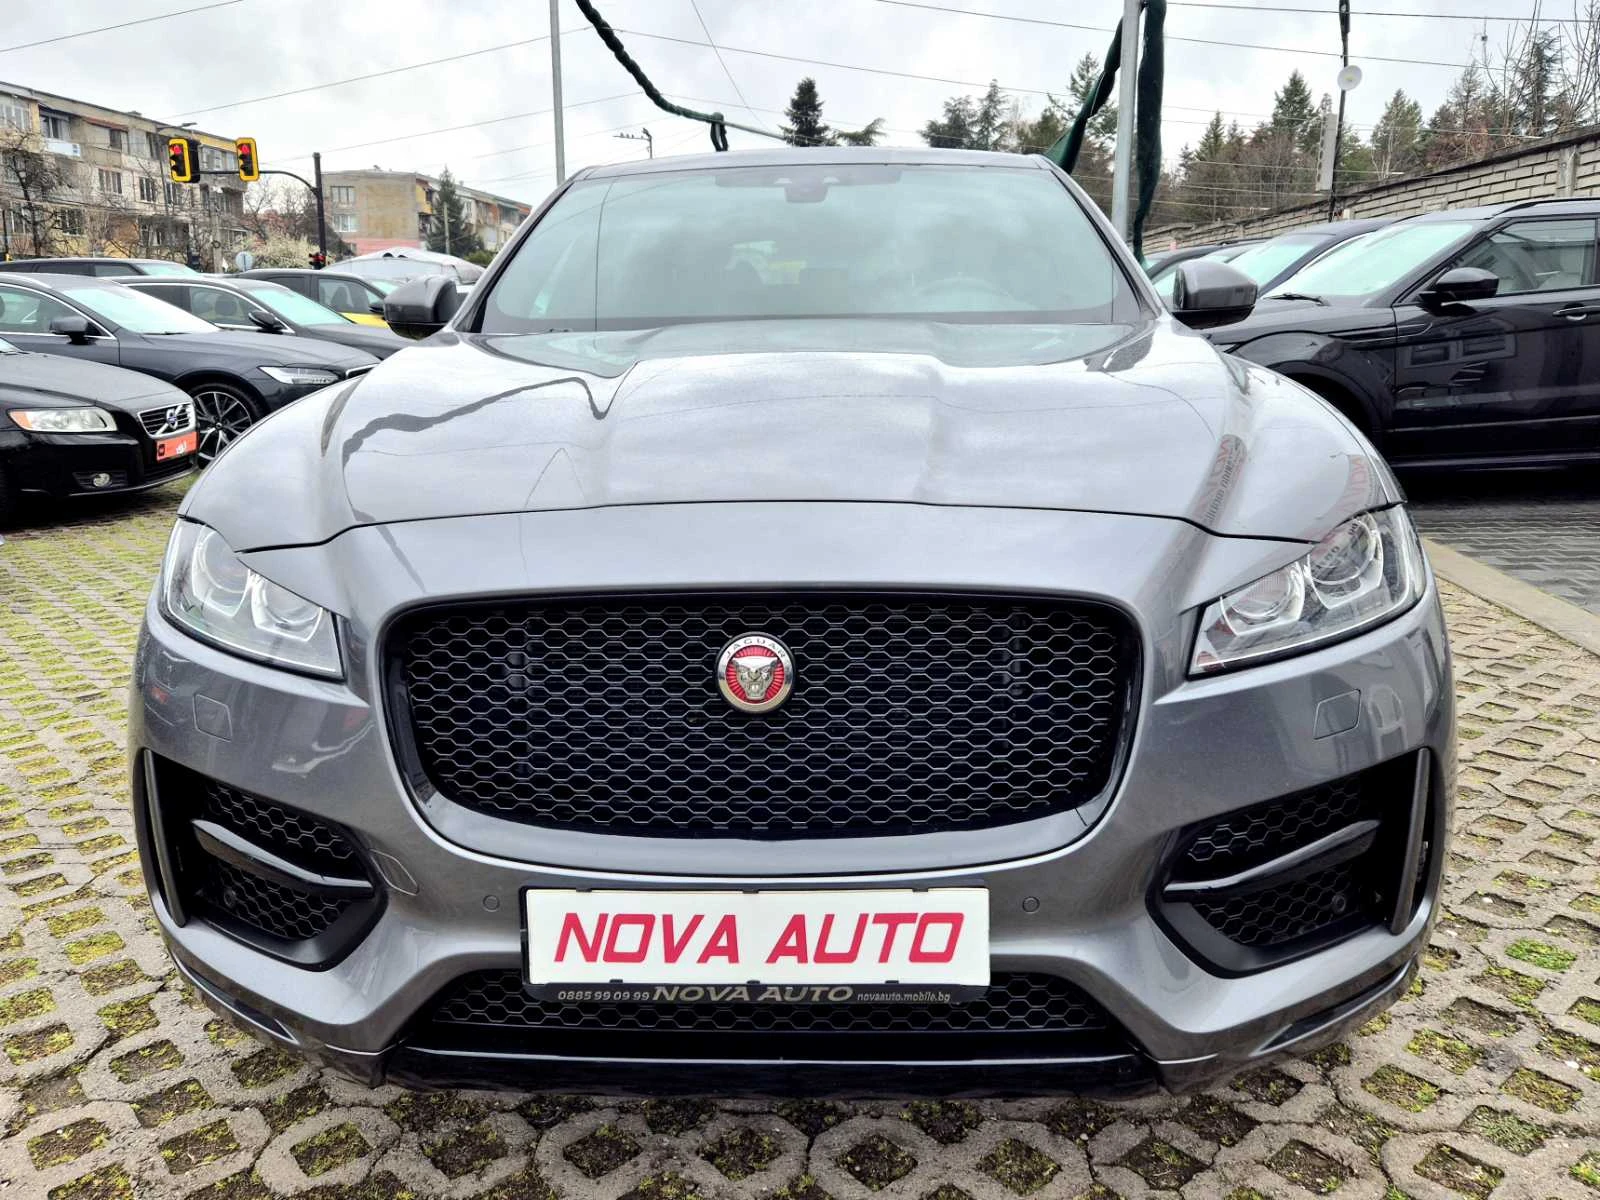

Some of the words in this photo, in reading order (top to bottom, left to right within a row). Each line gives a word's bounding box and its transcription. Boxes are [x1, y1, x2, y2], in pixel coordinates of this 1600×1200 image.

[726, 637, 786, 659] JAGUAR
[554, 912, 740, 964] NOVA
[765, 912, 965, 964] AUTO
[558, 990, 592, 1001] 0885
[652, 985, 750, 1002] NOVA
[757, 986, 854, 1002] AUTO
[857, 991, 951, 1004] novaauto.mobile.bg
